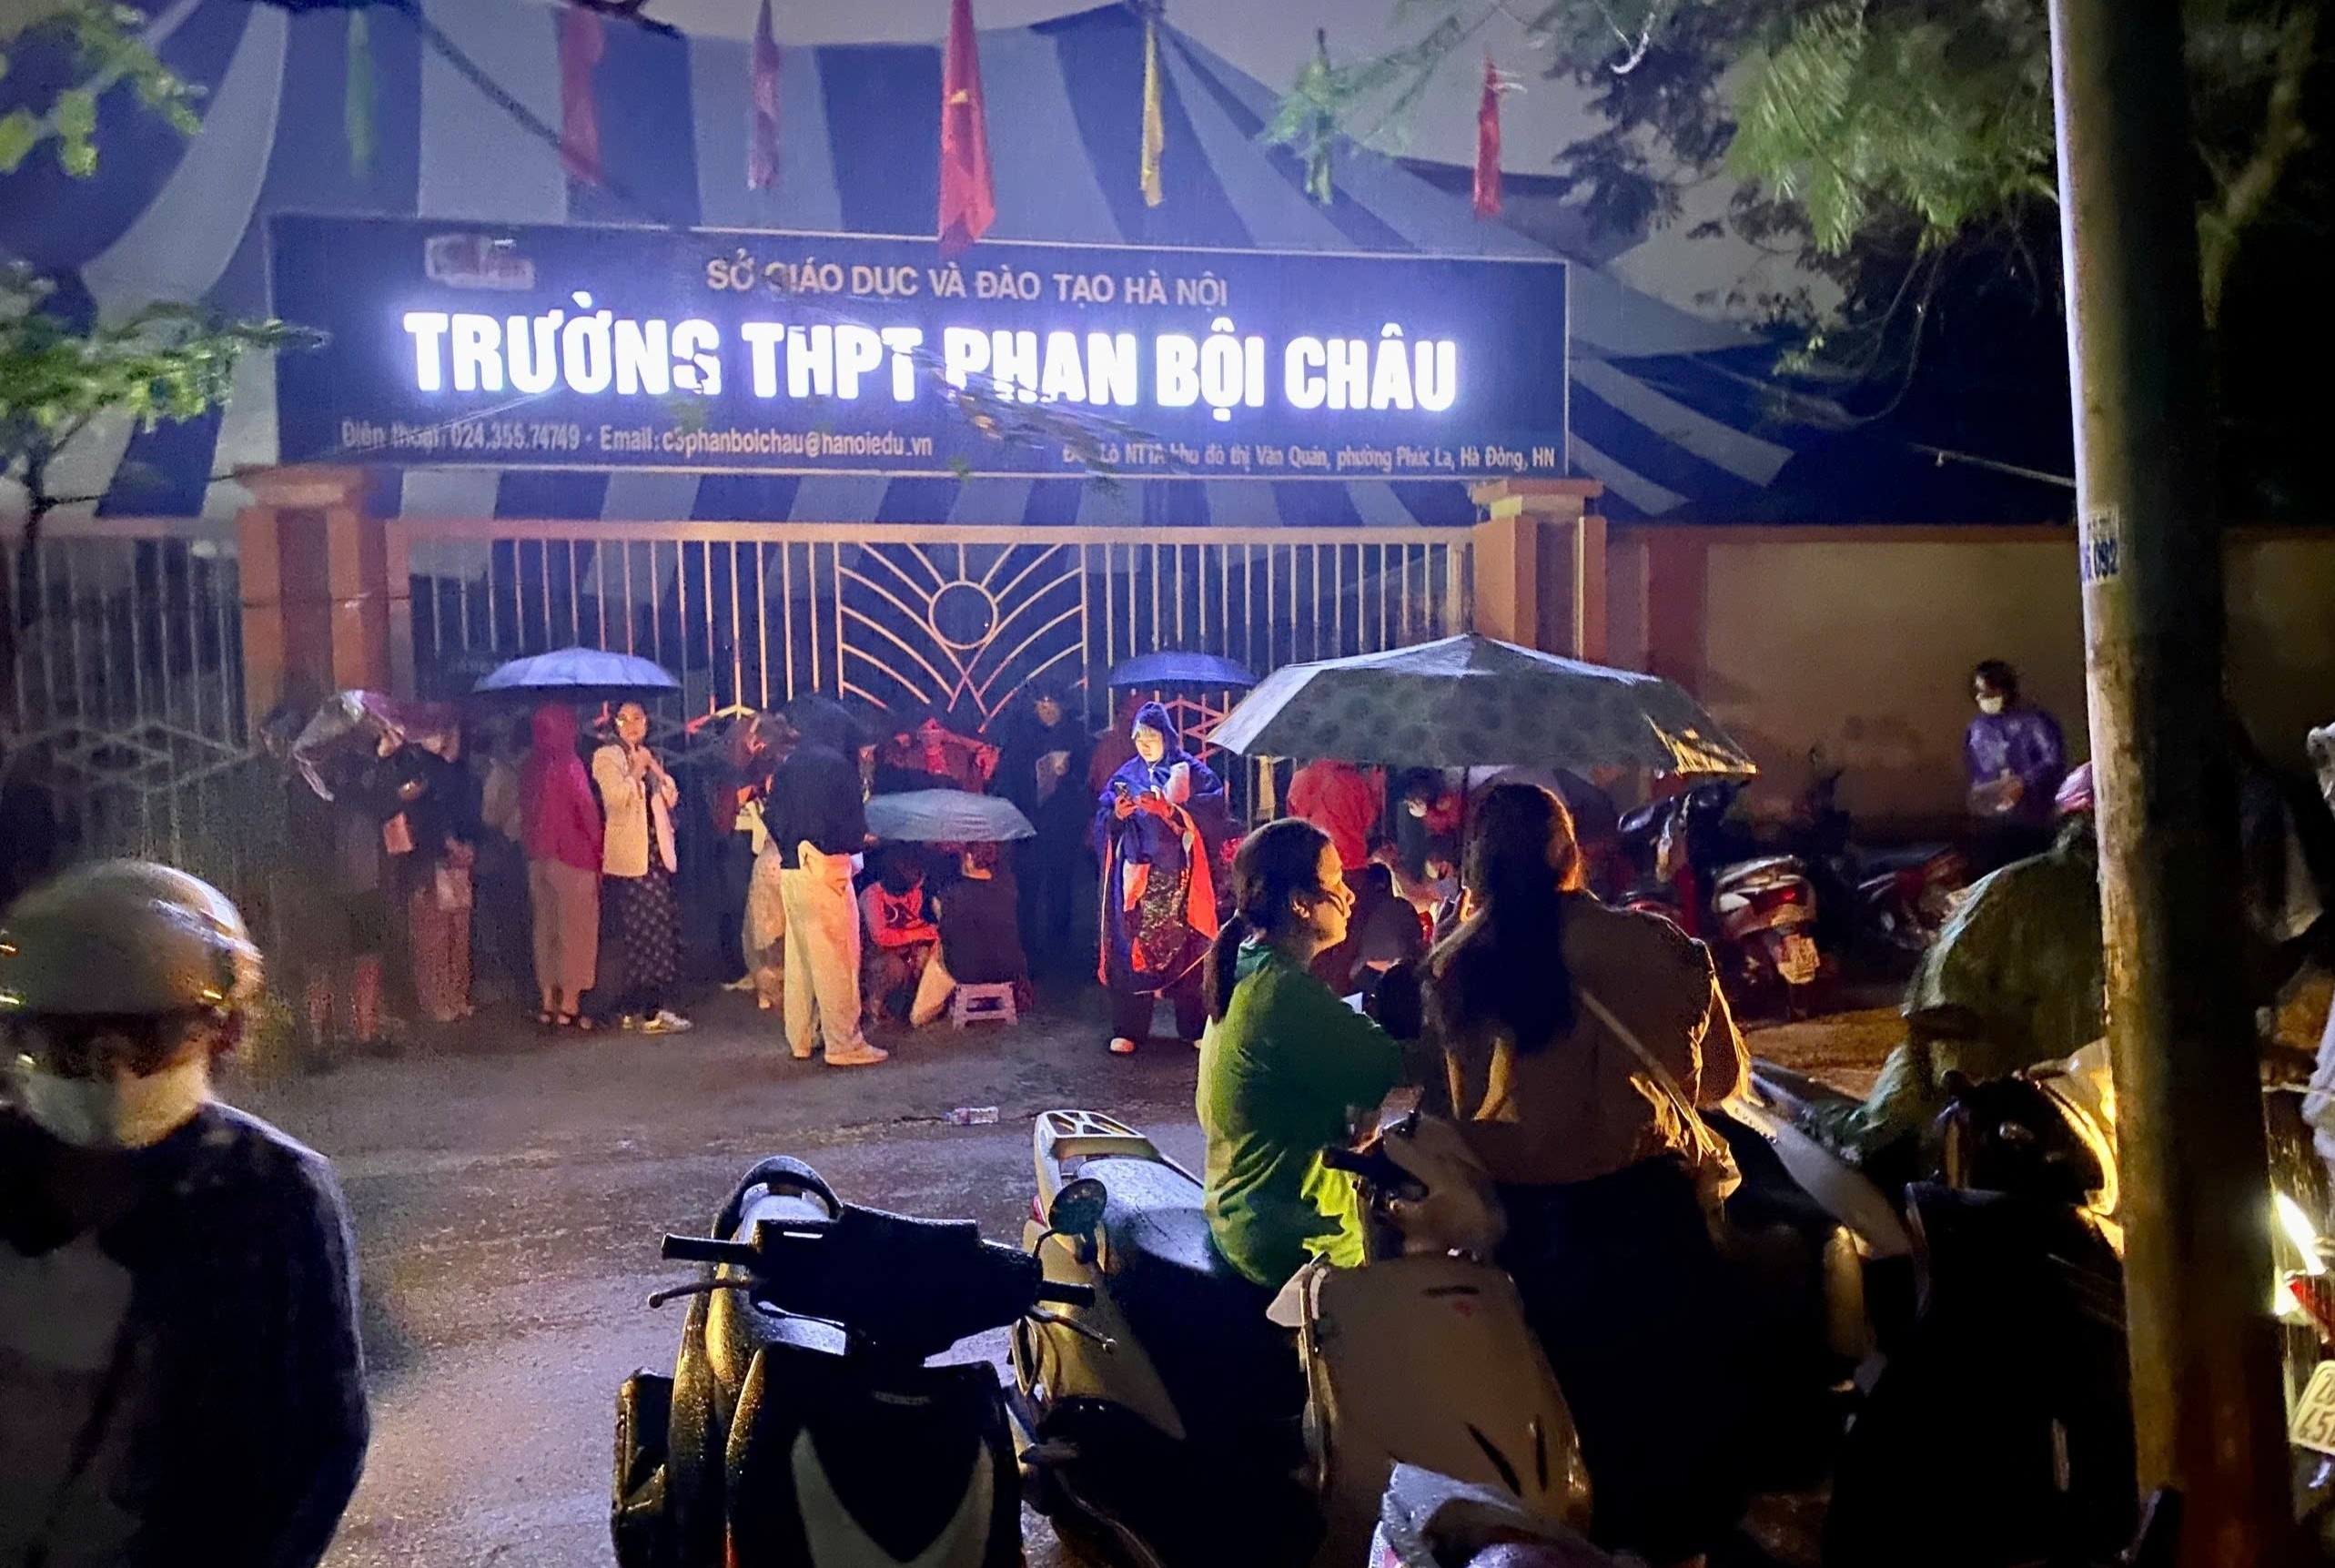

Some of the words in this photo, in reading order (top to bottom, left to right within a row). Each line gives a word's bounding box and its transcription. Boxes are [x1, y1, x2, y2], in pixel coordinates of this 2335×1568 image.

[707, 248, 753, 290] SỞ
[764, 257, 844, 293] GIÁO
[852, 266, 918, 300] DỤC
[928, 261, 966, 298] VÀ
[975, 264, 1041, 300] ĐÀO
[1053, 274, 1115, 309] TẠO
[1125, 269, 1168, 304] HÀ
[1177, 271, 1228, 312] NỘI
[403, 291, 723, 395] TRƯỜNG
[741, 322, 923, 402] THPT
[944, 327, 1137, 406] PHAN
[1156, 317, 1265, 421] BỘI
[1285, 322, 1457, 410] CHÂU
[1461, 445, 1481, 468] Hà
[1532, 447, 1555, 468] HN
